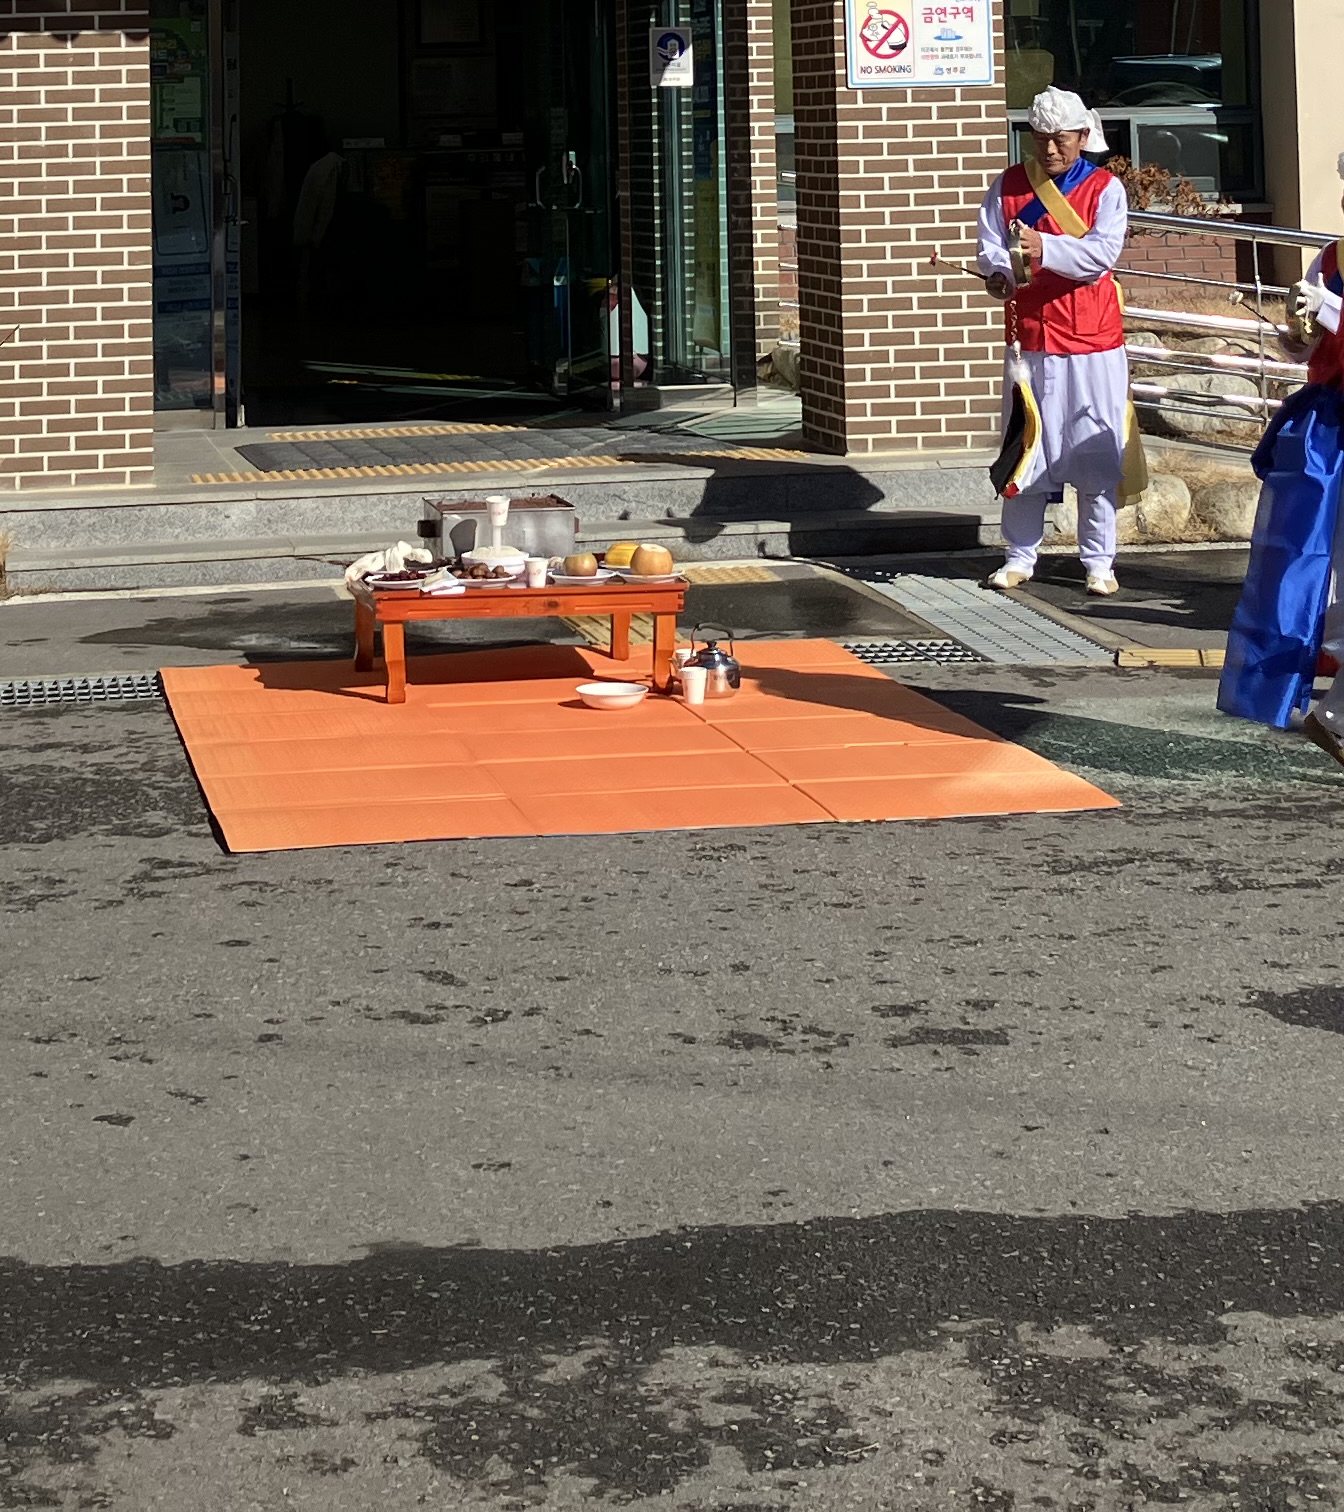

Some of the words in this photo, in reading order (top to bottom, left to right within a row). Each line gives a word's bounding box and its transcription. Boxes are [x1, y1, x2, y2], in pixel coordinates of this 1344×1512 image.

[921, 6, 974, 23] 금연구역
[860, 66, 873, 75] NO
[874, 65, 912, 74] SMOKING
